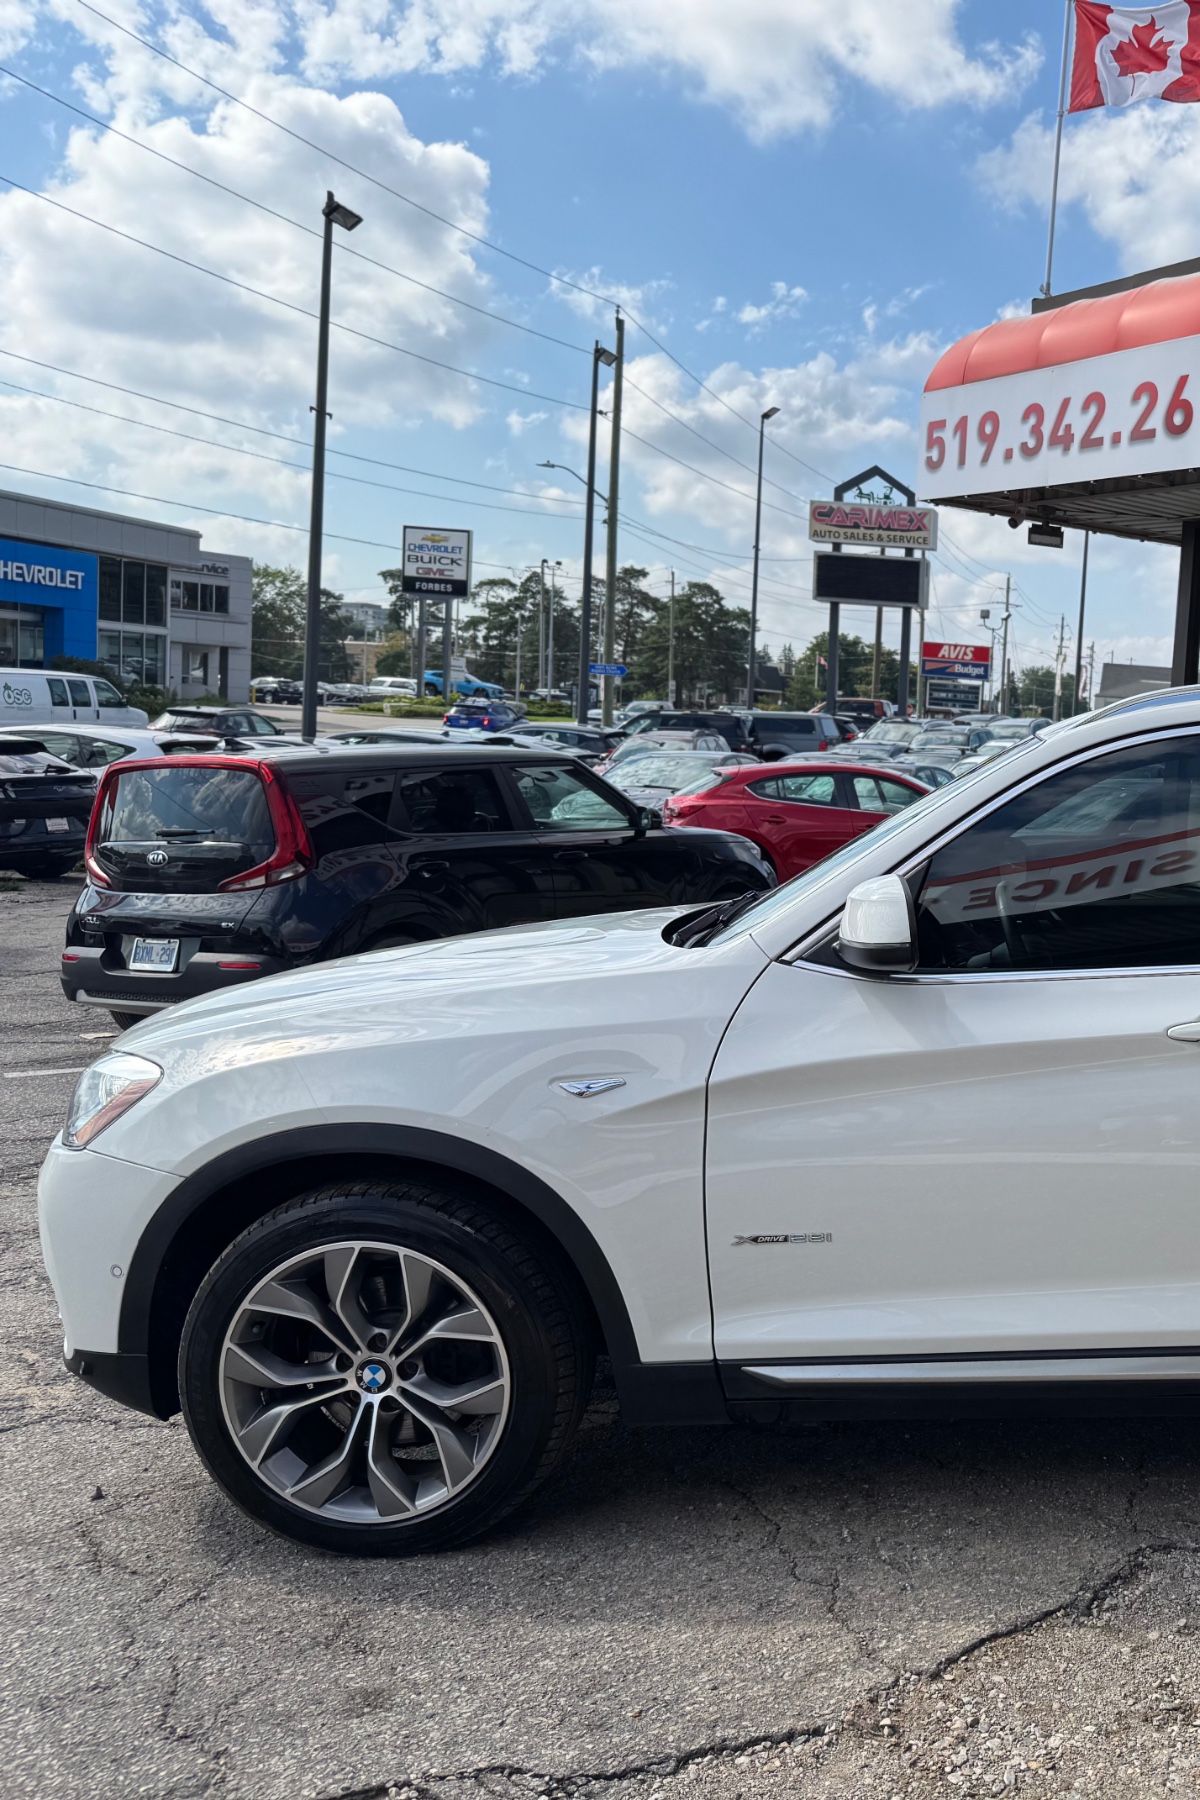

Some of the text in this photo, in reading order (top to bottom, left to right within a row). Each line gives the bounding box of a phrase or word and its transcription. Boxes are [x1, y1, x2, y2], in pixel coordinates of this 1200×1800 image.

[811, 505, 930, 531] CARIMEX
[812, 529, 929, 545] AUTO SALES & SERVICE
[408, 543, 463, 554] CHEVROLET
[407, 554, 463, 567] BUICK
[0, 560, 85, 590] HEVROLET
[200, 563, 229, 576] rvice
[416, 567, 454, 577] GMC
[415, 582, 453, 593] FORBES
[938, 645, 975, 660] AVIS
[954, 664, 984, 677] Budget
